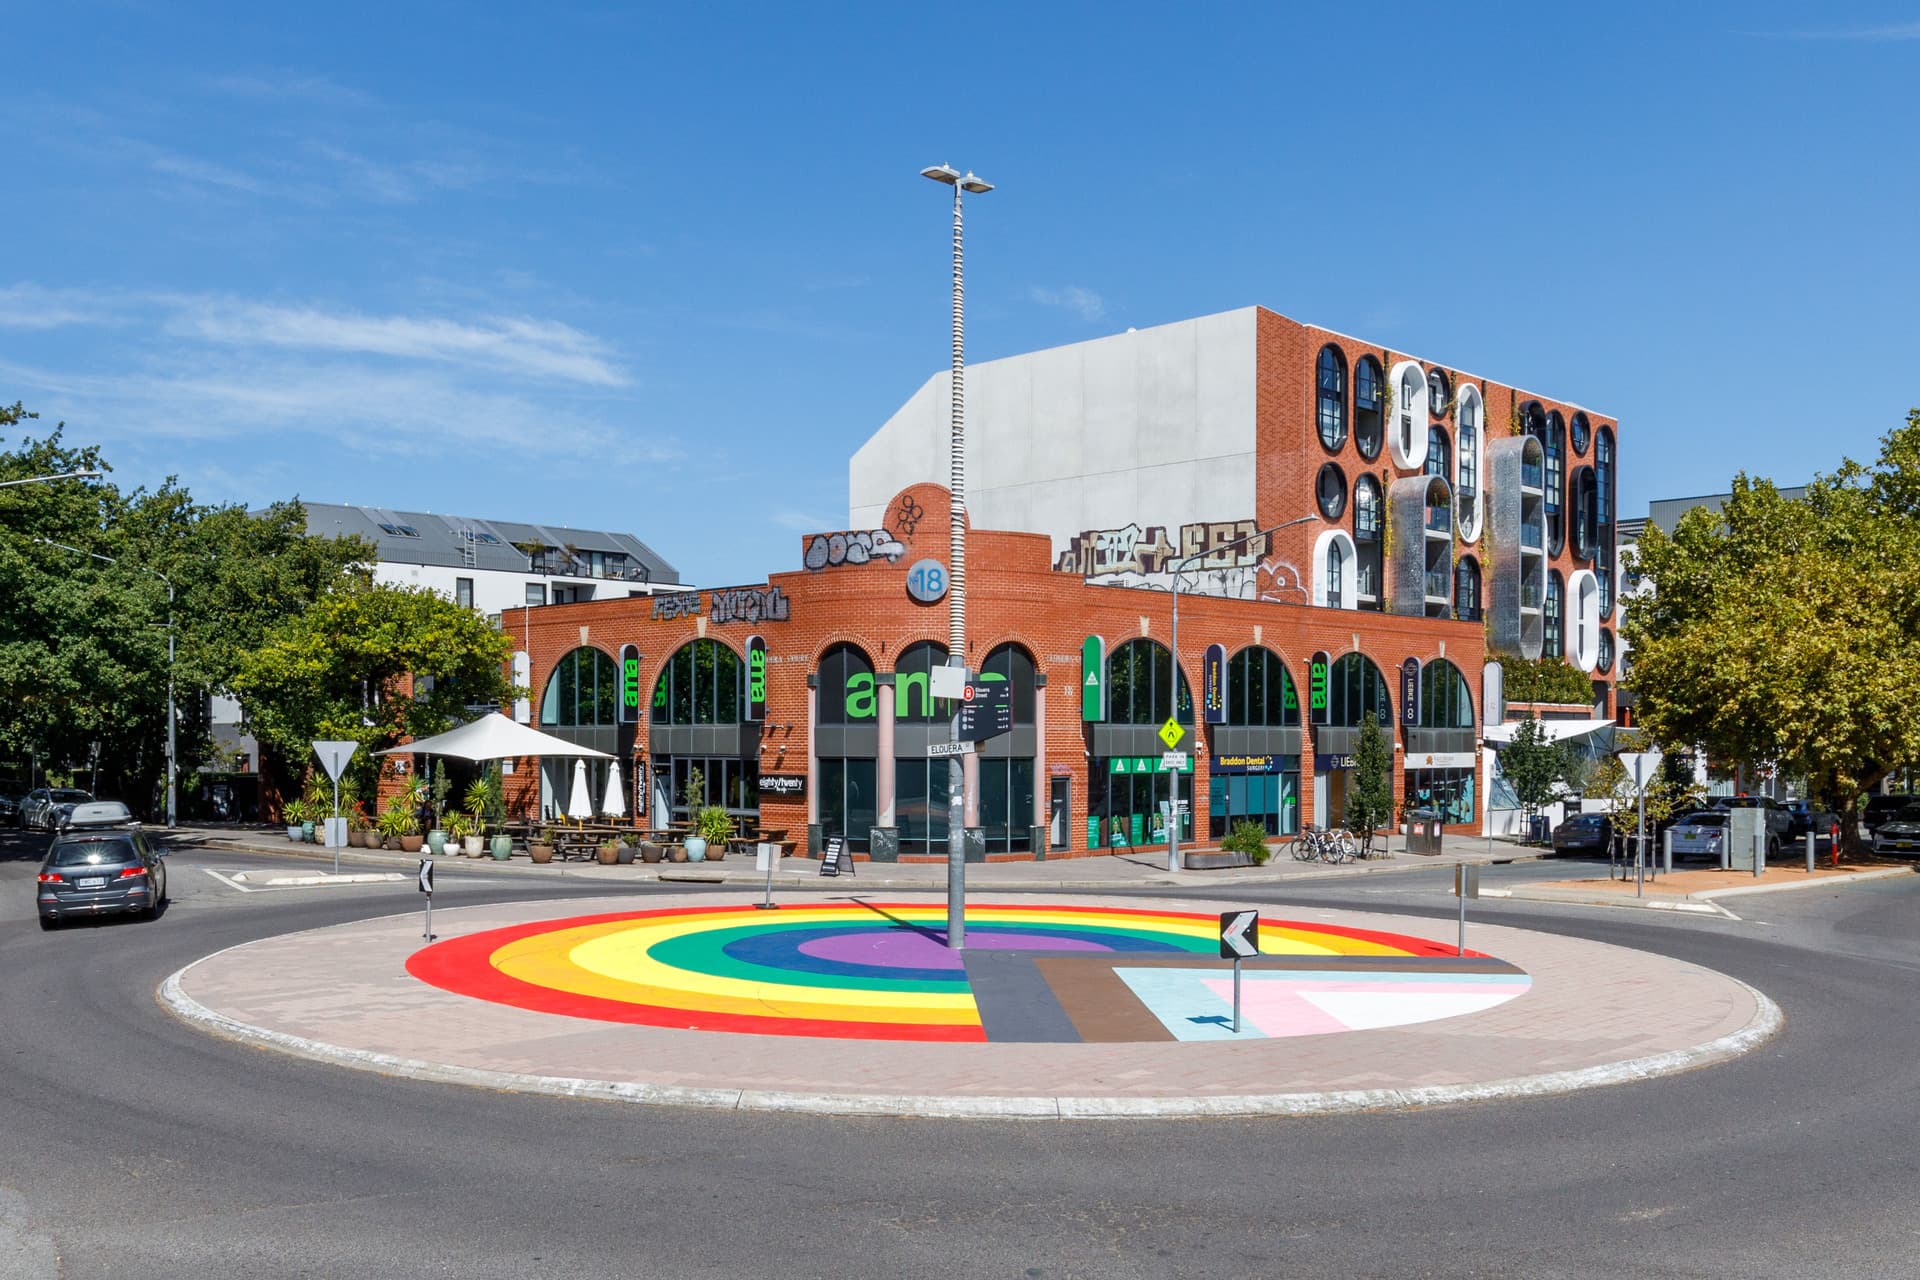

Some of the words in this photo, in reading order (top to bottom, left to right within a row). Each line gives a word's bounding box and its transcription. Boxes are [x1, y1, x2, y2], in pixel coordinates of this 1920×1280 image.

[916, 568, 943, 593] 18
[624, 659, 638, 707] ama
[752, 648, 765, 702] ama
[1312, 663, 1327, 709] ama
[931, 744, 964, 755] ELOUERA
[1220, 755, 1246, 766] Braddon
[1246, 755, 1265, 765] Dental
